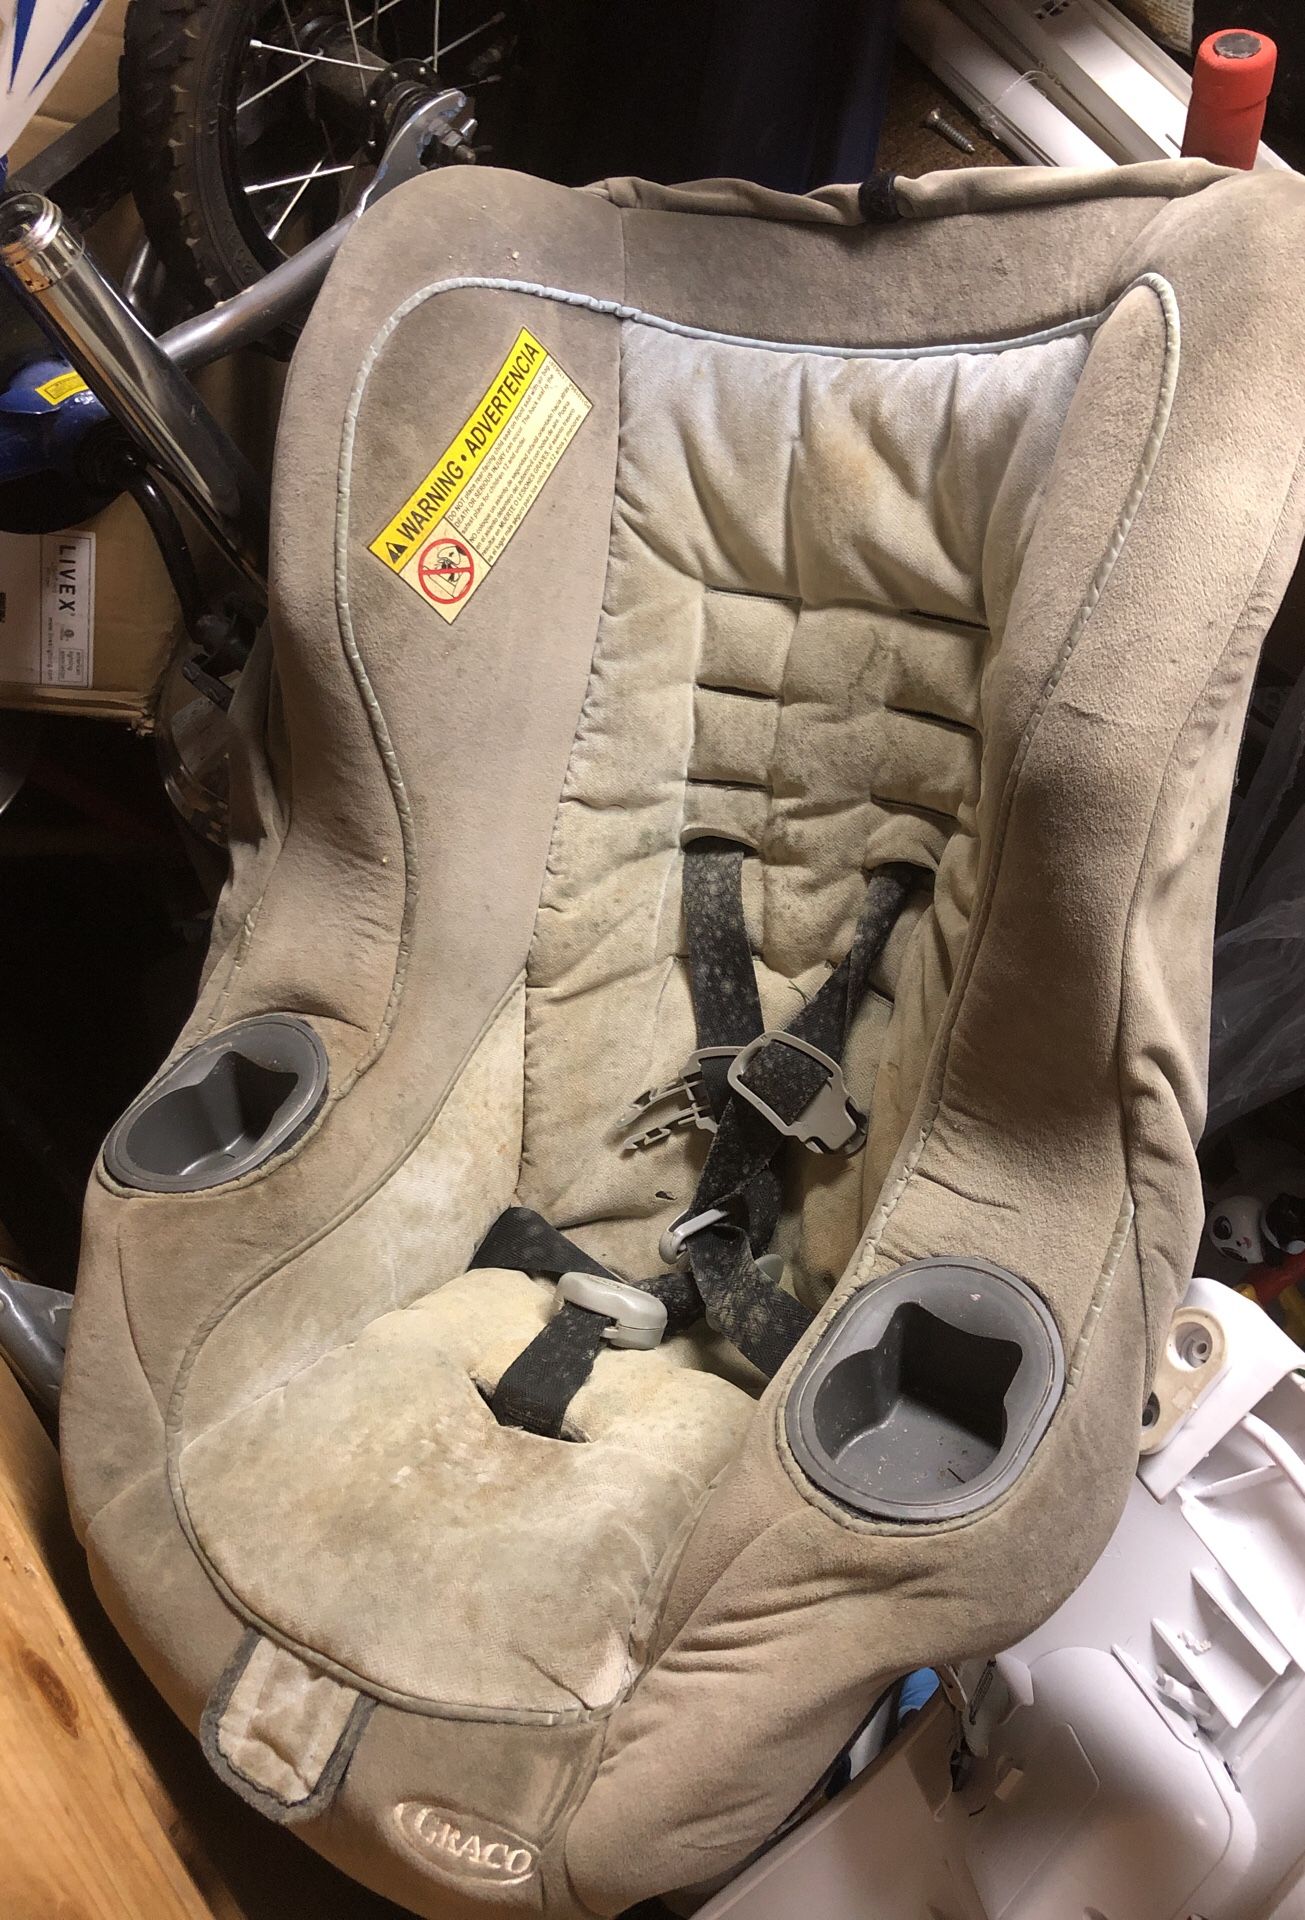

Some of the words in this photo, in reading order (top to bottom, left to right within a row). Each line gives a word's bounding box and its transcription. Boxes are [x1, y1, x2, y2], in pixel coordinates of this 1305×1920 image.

[397, 461, 464, 542] WARNING
[464, 342, 540, 458] ADVERTENCIA
[453, 505, 470, 528] DEATH
[473, 471, 493, 499] SERIOUS
[490, 451, 506, 474] INJURY
[504, 440, 513, 453] can
[521, 412, 530, 425] The
[454, 496, 465, 512] NOT
[463, 481, 476, 500] place
[481, 491, 490, 503] for
[498, 503, 516, 529] MUERTE
[58, 544, 76, 612] LIVEX
[414, 1807, 532, 1874] GRACO
